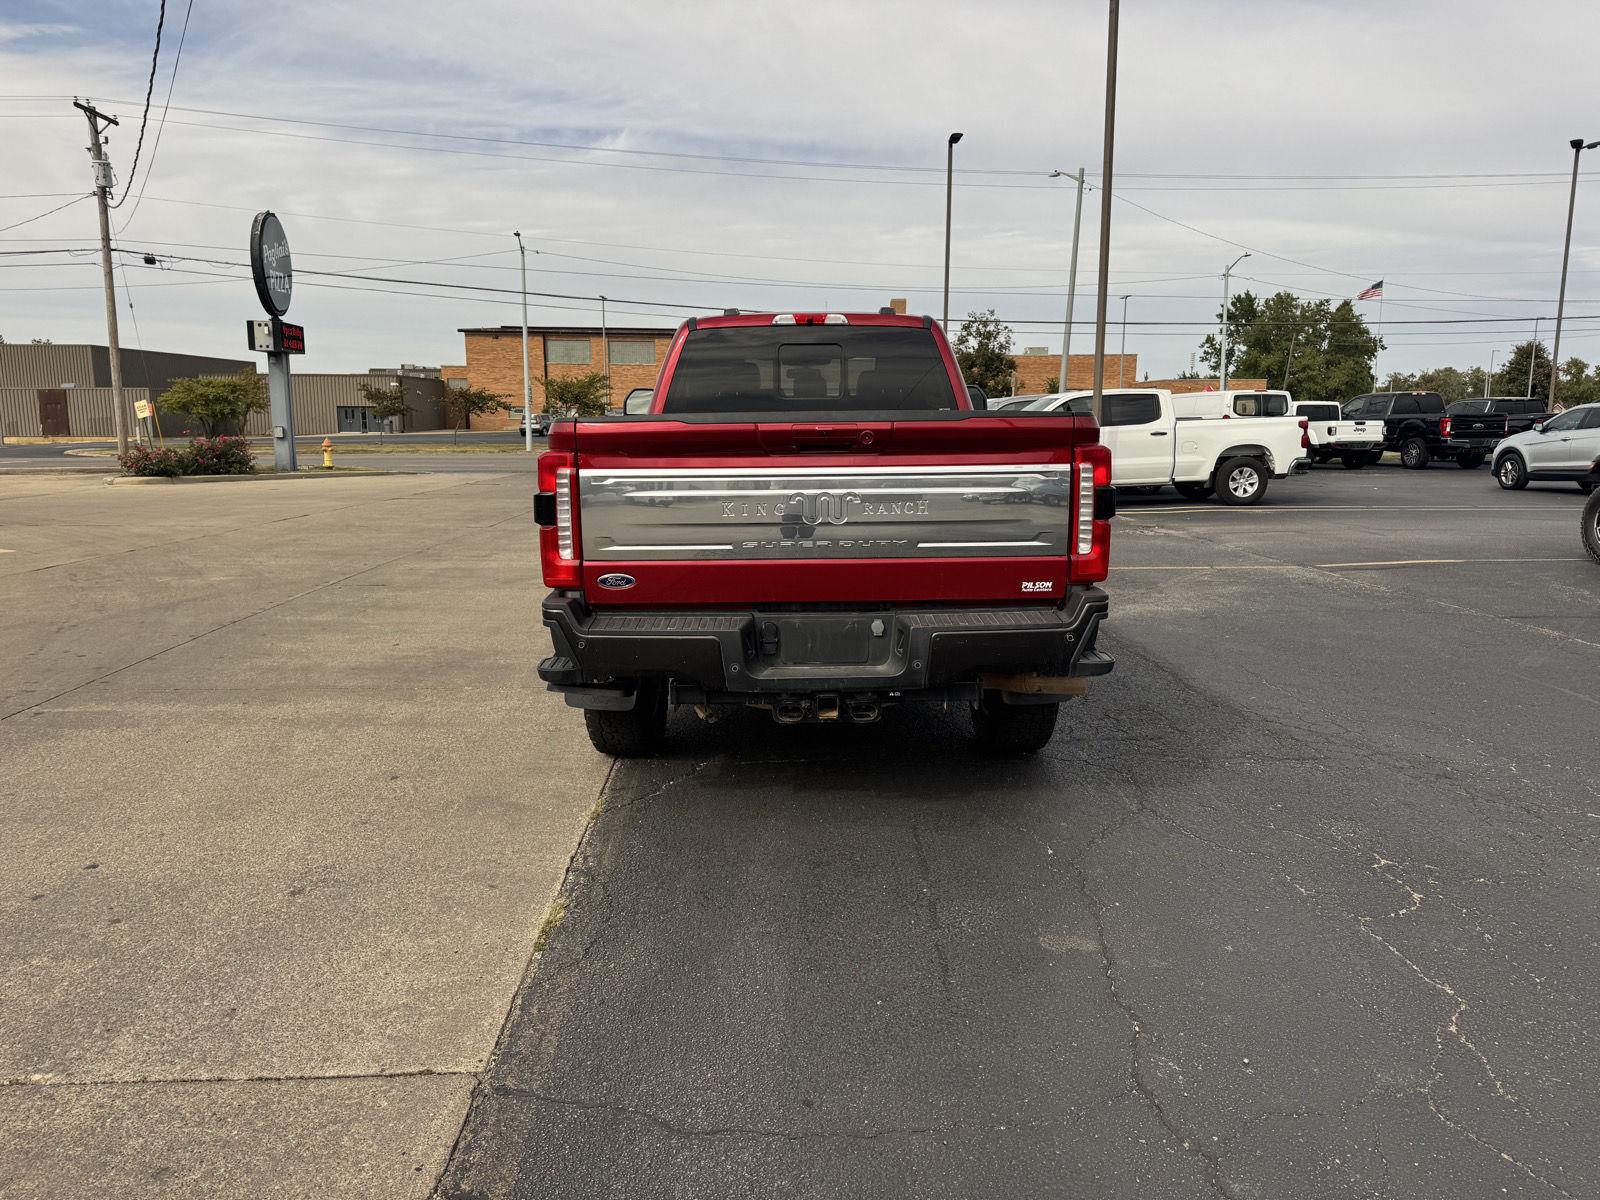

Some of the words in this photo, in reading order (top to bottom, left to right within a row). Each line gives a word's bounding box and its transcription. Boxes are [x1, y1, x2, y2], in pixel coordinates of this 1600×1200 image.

[270, 270, 290, 294] PIZZA
[721, 502, 785, 517] KING
[863, 500, 929, 515] RANCH
[742, 541, 832, 549] SUPER
[839, 540, 908, 549] DUTY
[606, 576, 627, 585] Ford
